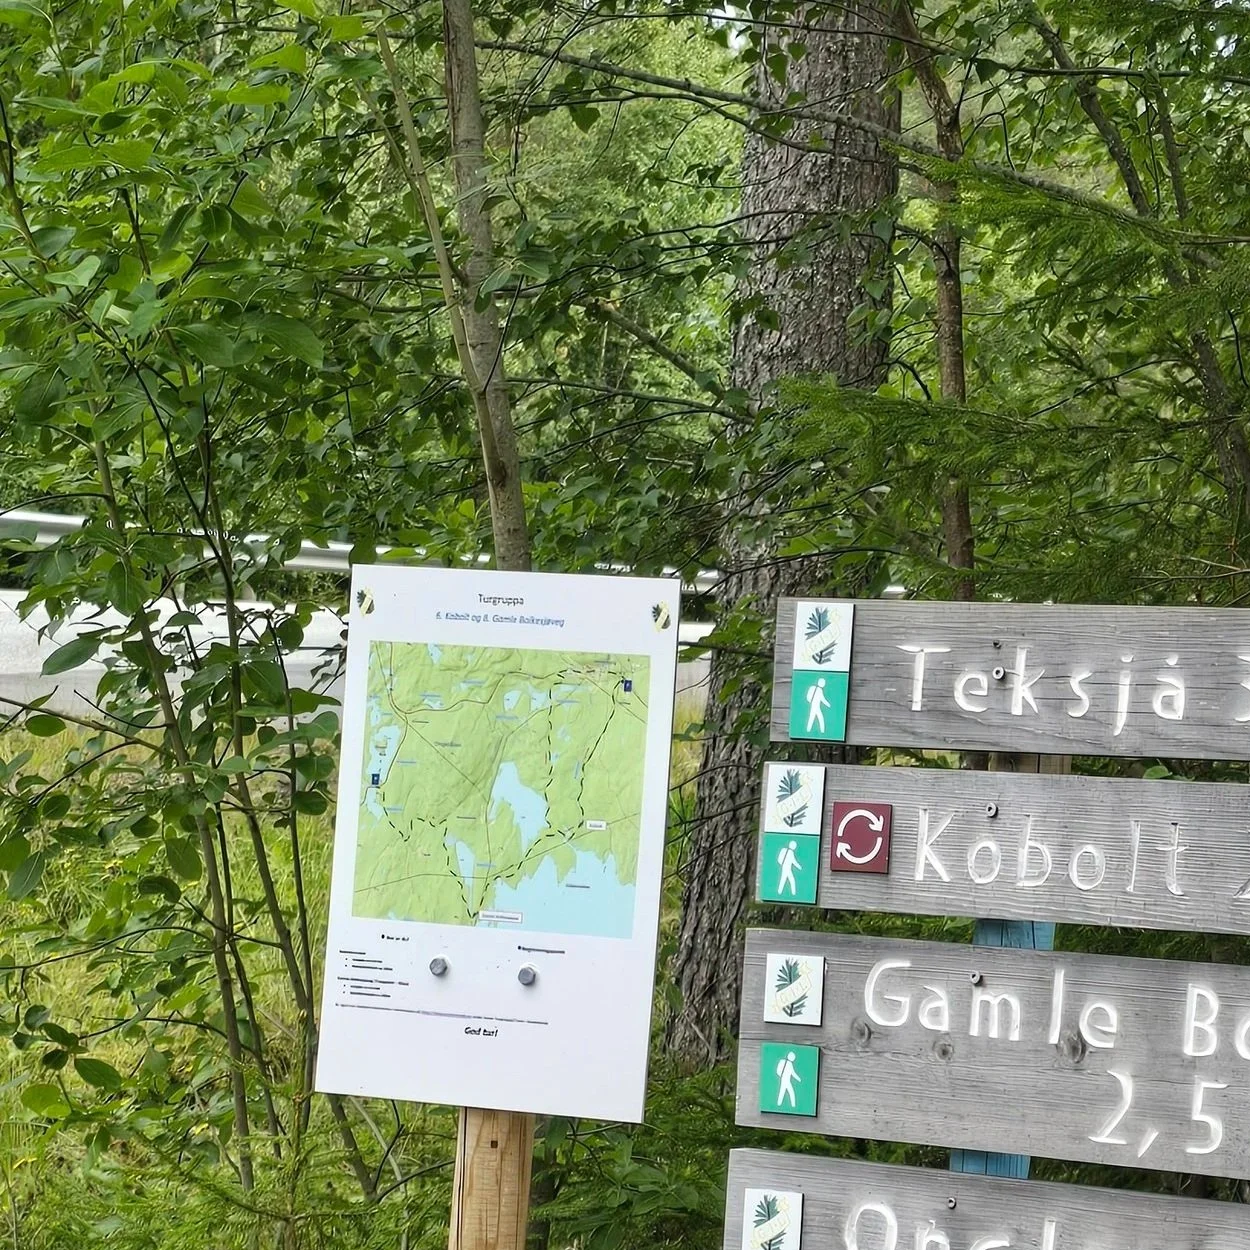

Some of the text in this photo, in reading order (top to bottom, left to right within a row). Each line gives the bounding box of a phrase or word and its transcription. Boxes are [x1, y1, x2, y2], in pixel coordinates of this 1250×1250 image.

[478, 593, 524, 606] Turgruppa
[896, 645, 1186, 737] Teksjå
[914, 808, 1189, 897] Kobolt
[864, 959, 1121, 1048] Gamle
